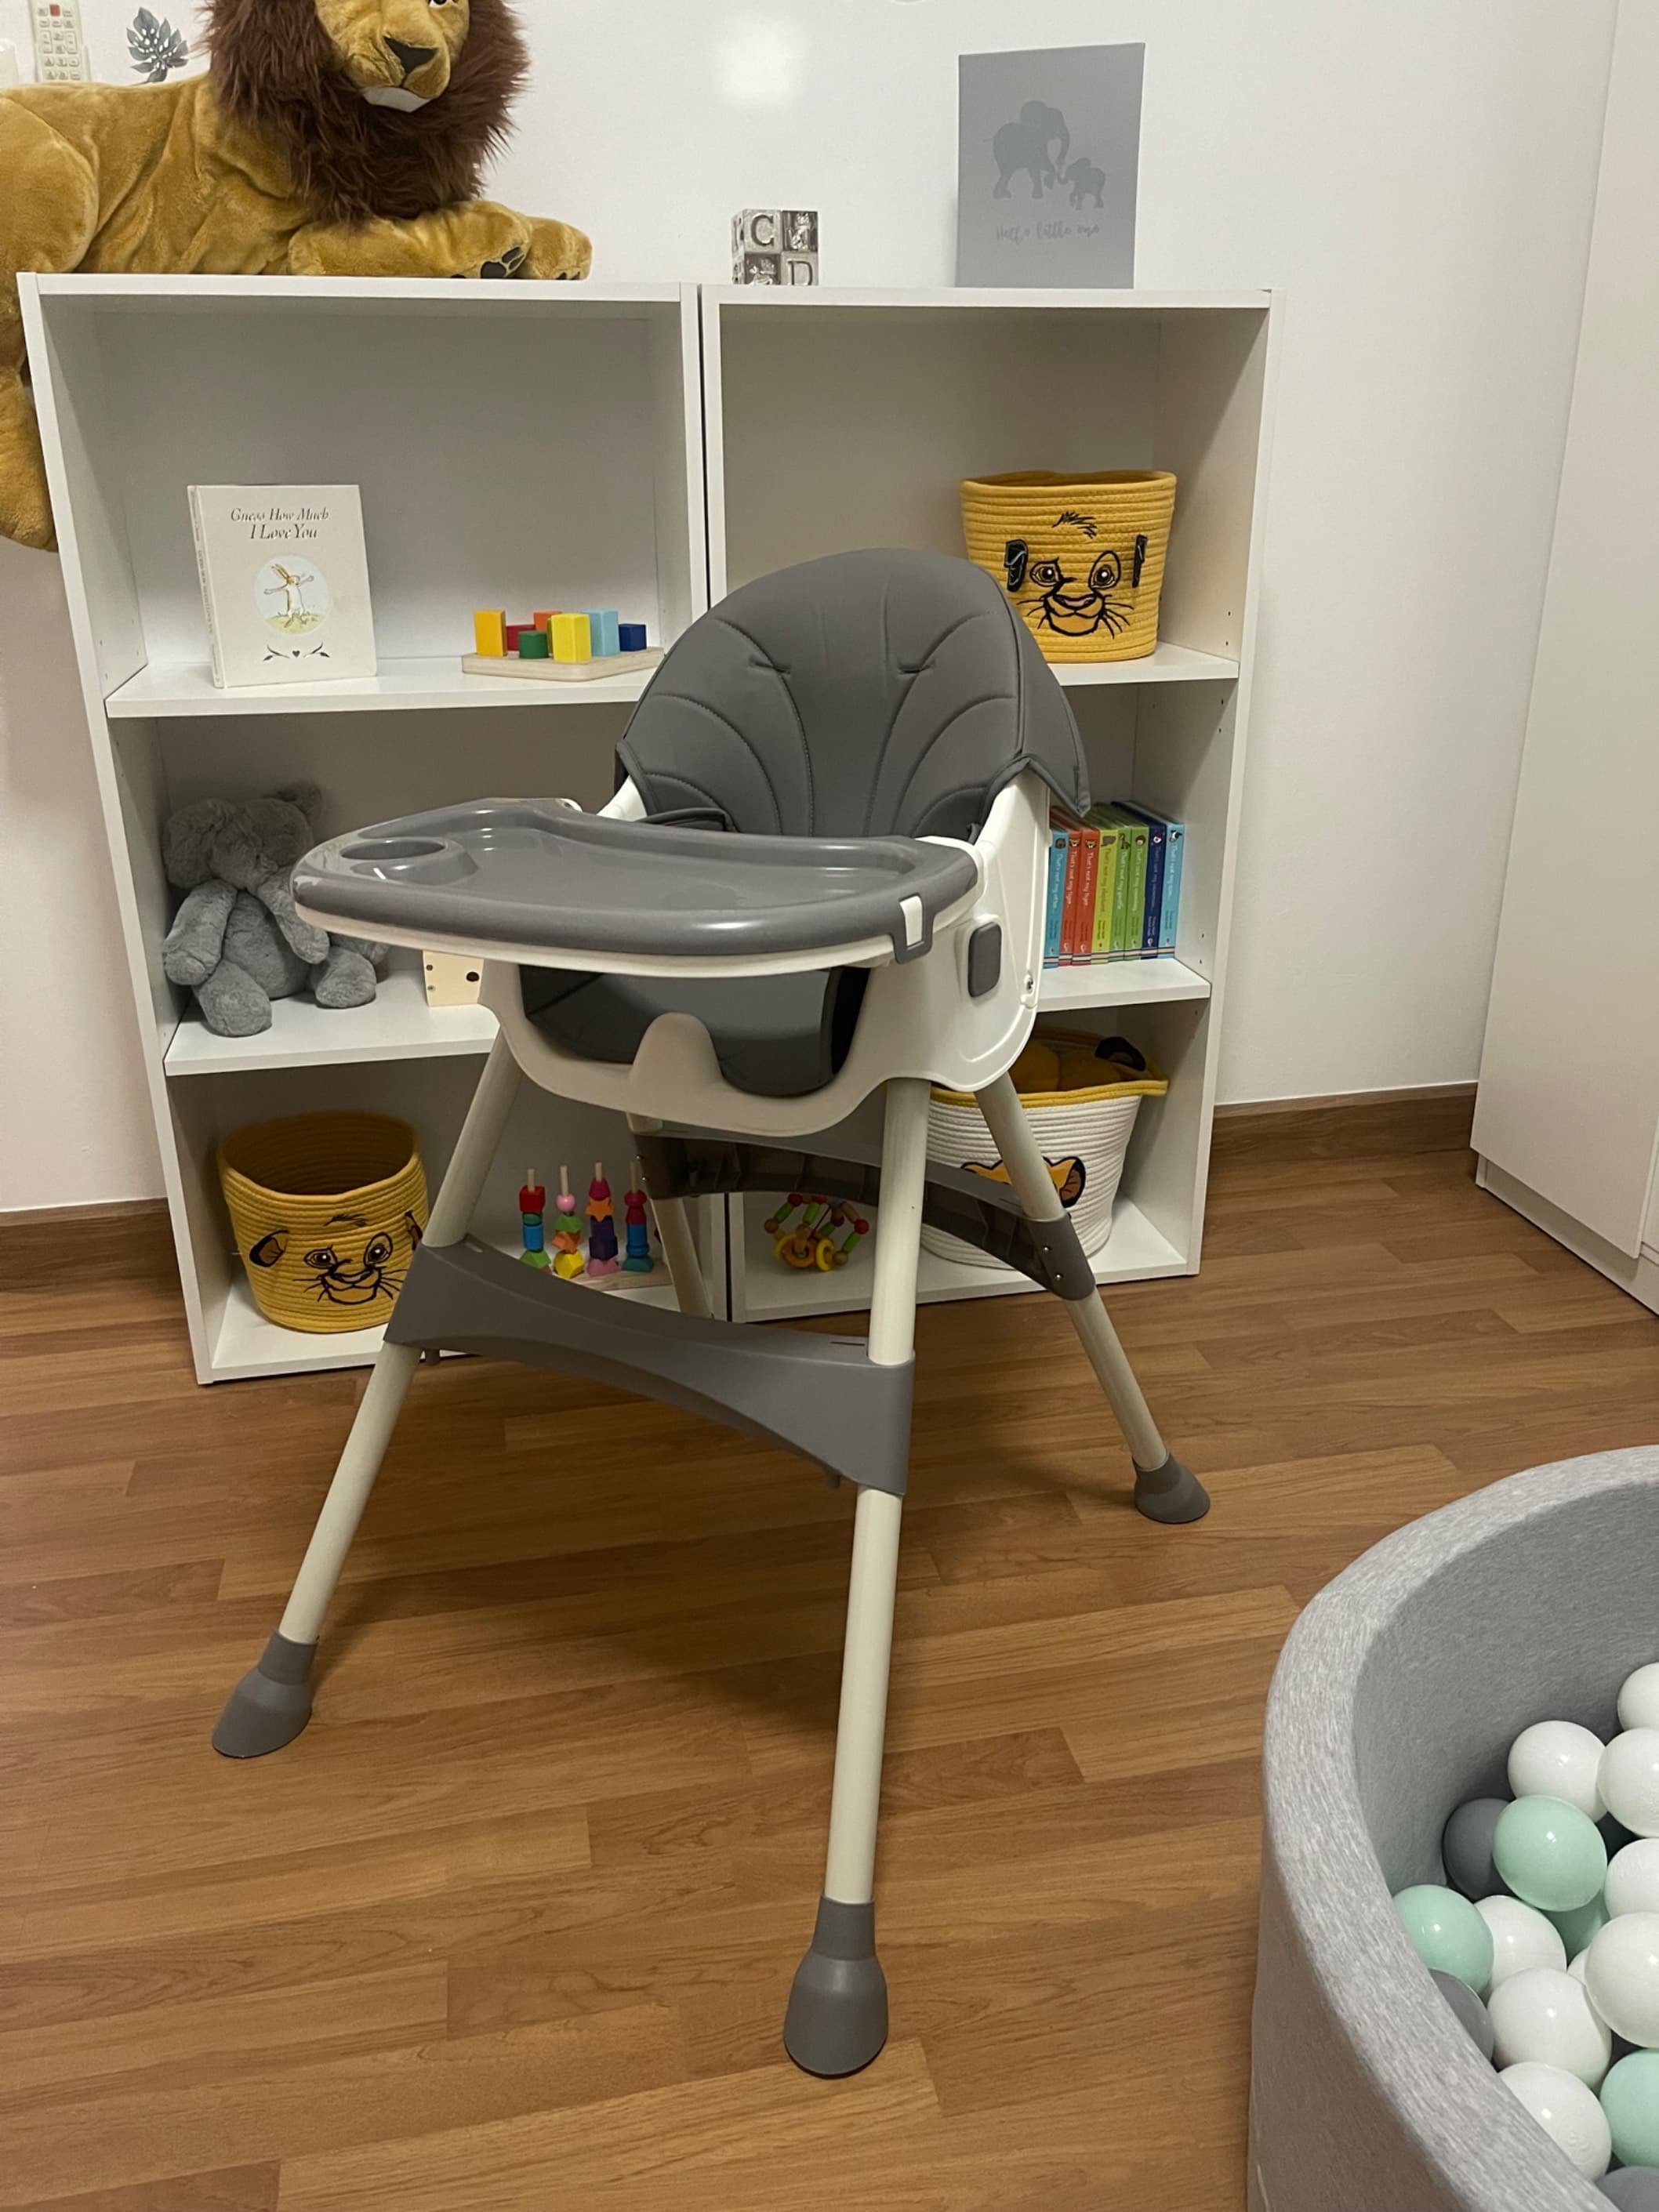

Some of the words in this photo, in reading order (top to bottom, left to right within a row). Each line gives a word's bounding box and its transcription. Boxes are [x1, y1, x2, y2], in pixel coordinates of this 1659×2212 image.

[750, 214, 775, 247] C
[1036, 220, 1073, 239] little
[231, 507, 265, 521] Guess
[269, 507, 295, 521] How
[296, 506, 329, 520] Much
[250, 524, 256, 539] I
[260, 524, 292, 539] Love
[294, 523, 318, 539] You
[1066, 879, 1073, 890] my
[1082, 882, 1090, 891] my
